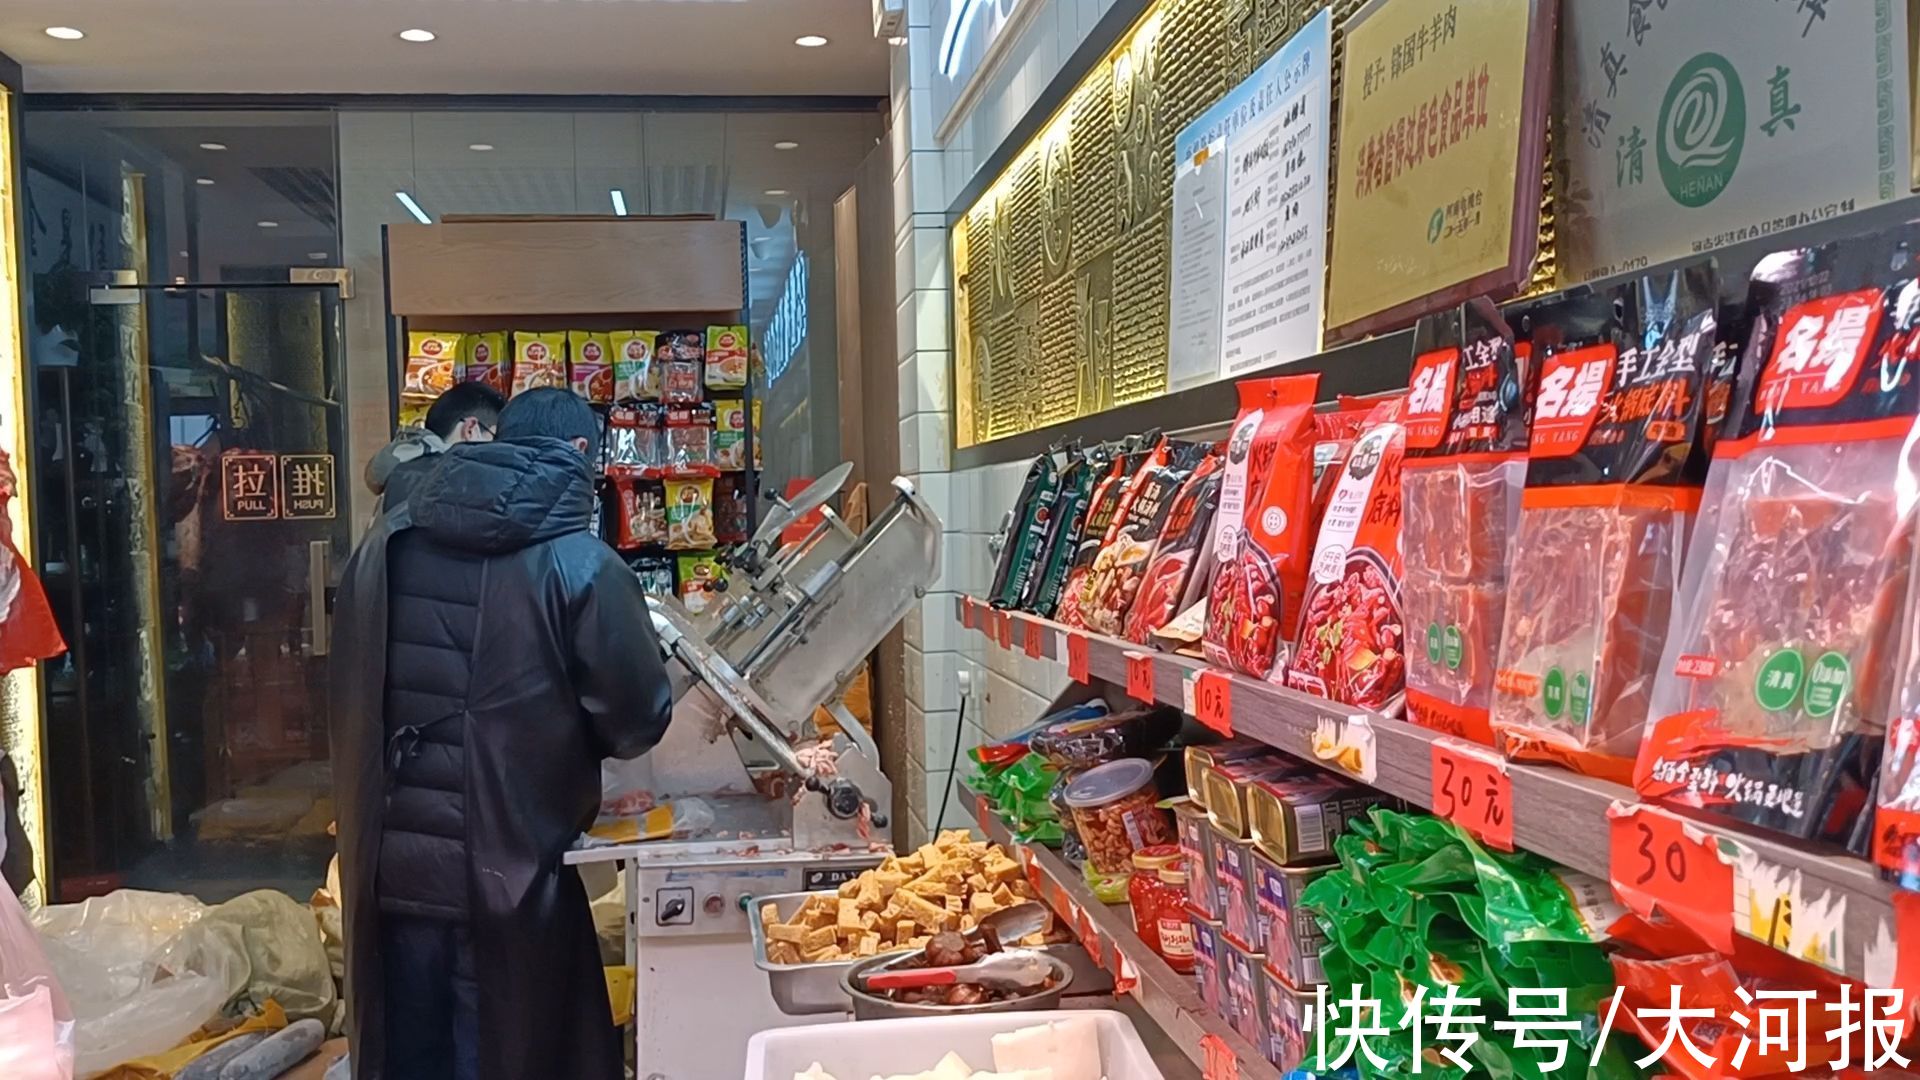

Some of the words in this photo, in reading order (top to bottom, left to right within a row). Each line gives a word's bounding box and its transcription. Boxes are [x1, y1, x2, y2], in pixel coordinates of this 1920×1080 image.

[1616, 125, 1648, 188] 清
[1760, 65, 1801, 137] 真
[1679, 173, 1724, 199] HENAN
[233, 464, 266, 498] 拉
[237, 500, 266, 511] PULL
[1764, 669, 1796, 690] 清真
[1632, 829, 1687, 886] 30
